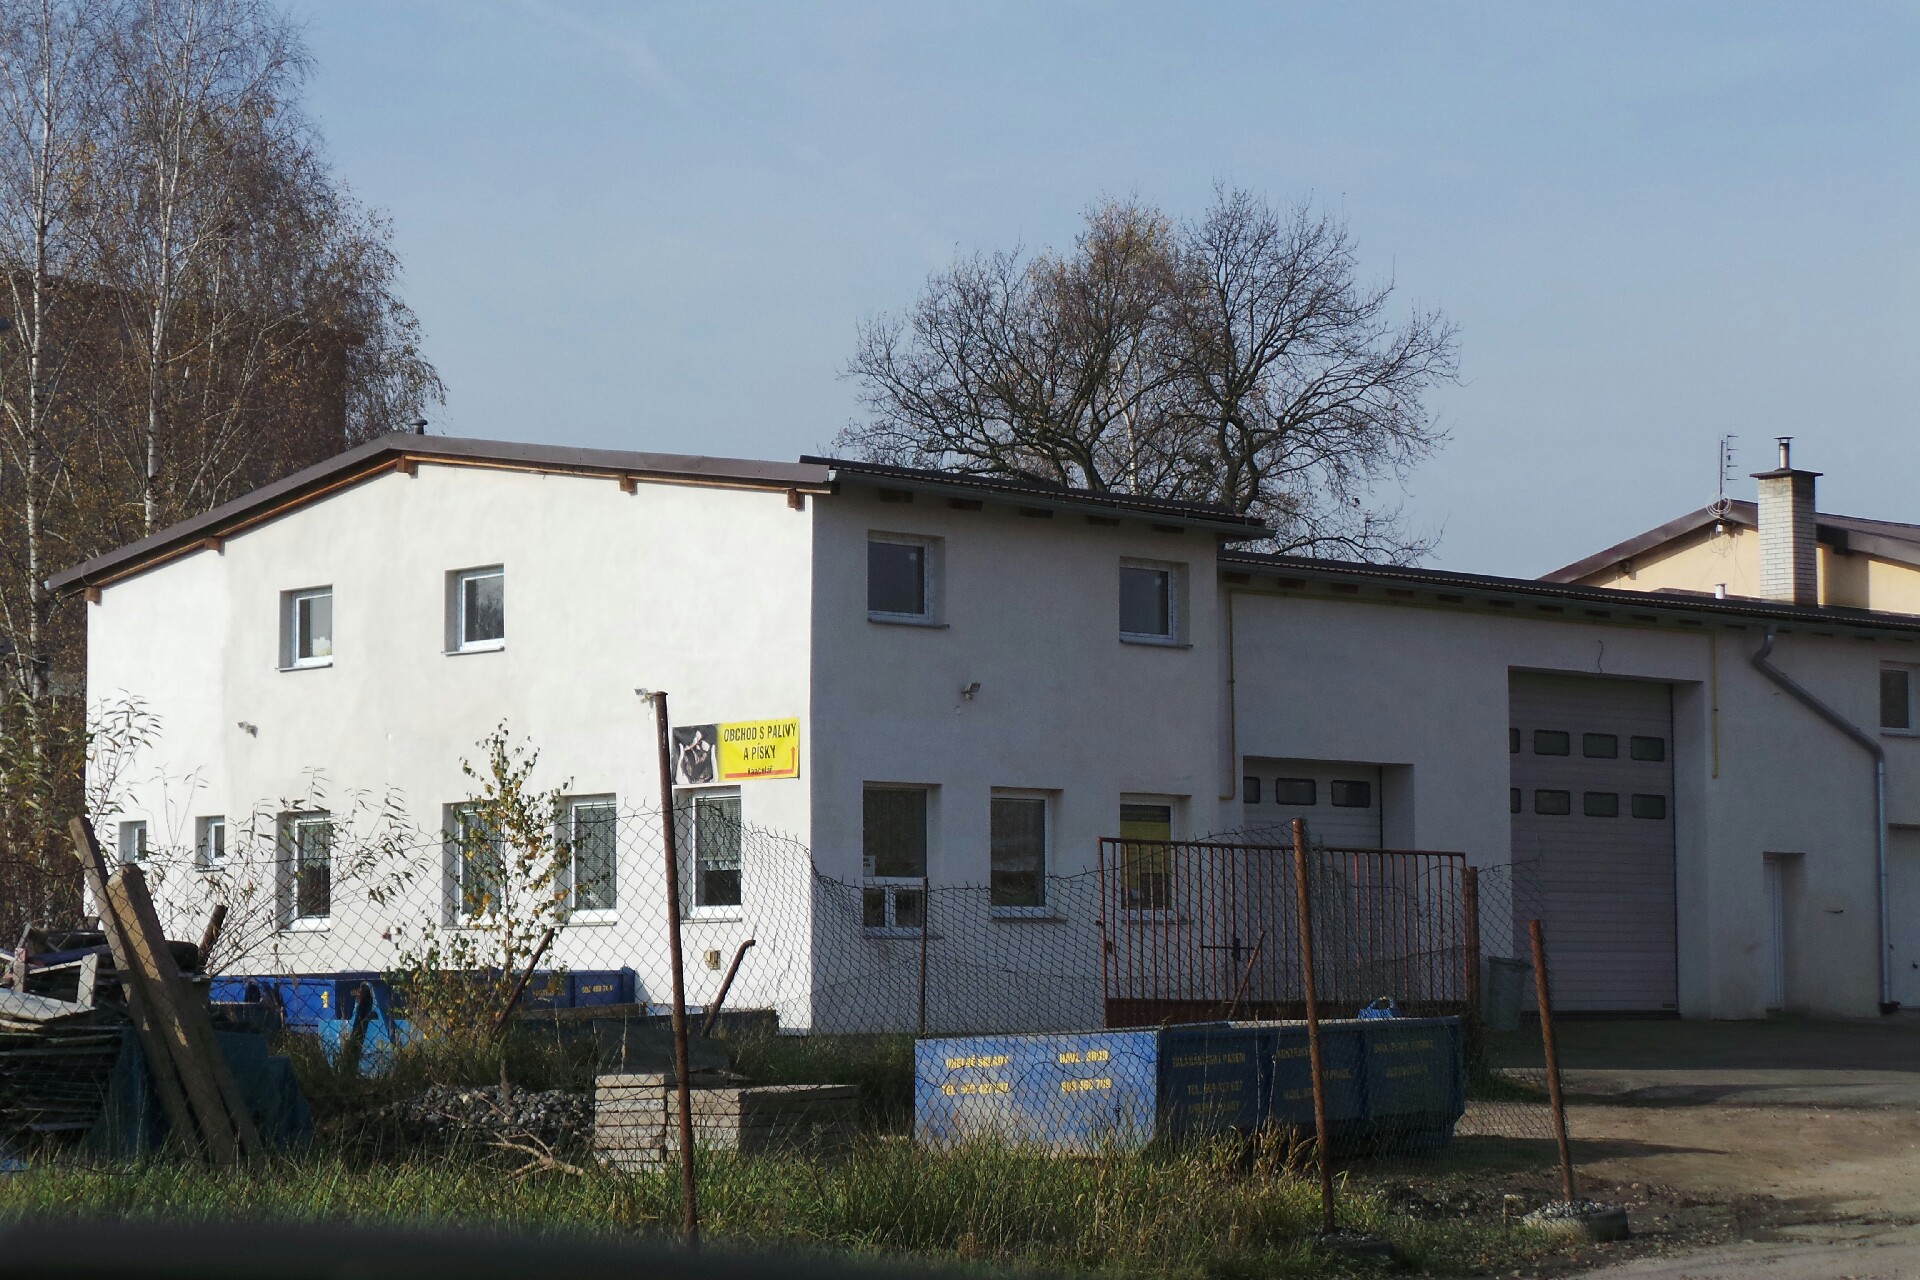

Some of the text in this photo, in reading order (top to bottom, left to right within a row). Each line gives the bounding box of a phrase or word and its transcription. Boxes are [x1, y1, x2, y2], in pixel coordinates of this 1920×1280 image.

[724, 723, 796, 742] OBCHOD S PALIVY
[743, 742, 776, 761] A PÍSKY
[320, 991, 329, 1009] 1
